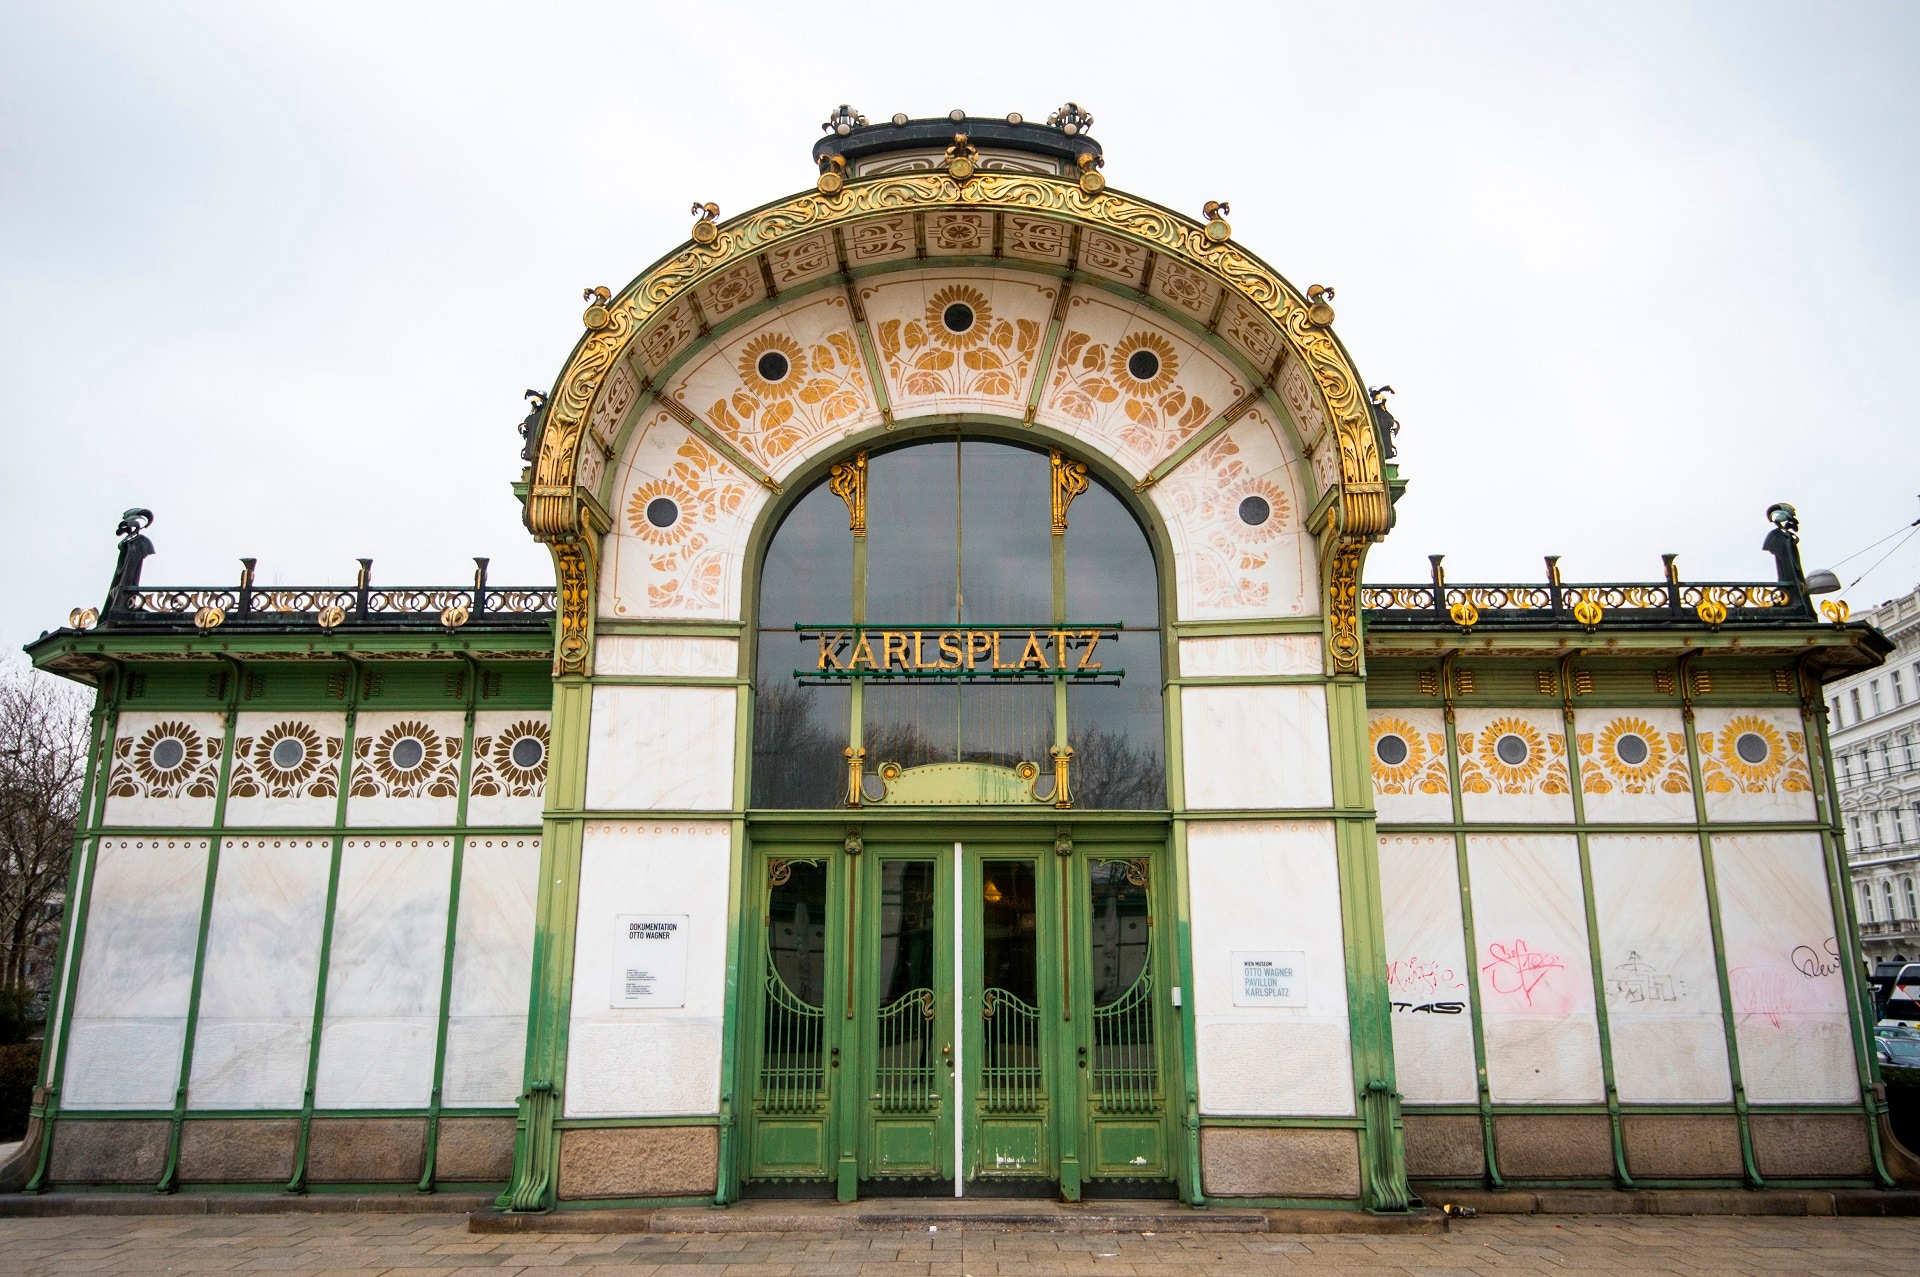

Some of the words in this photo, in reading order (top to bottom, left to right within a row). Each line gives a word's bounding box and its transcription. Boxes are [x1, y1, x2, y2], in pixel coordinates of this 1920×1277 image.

[817, 631, 1103, 669] KARLSPLATZ
[629, 931, 644, 939] OTTO
[645, 931, 670, 939] WAGNER
[1244, 968, 1262, 977] OTTO
[1263, 968, 1293, 977] WAGNER
[1245, 978, 1277, 987] PAVILLON
[1245, 988, 1289, 997] KARLSPLATZ
